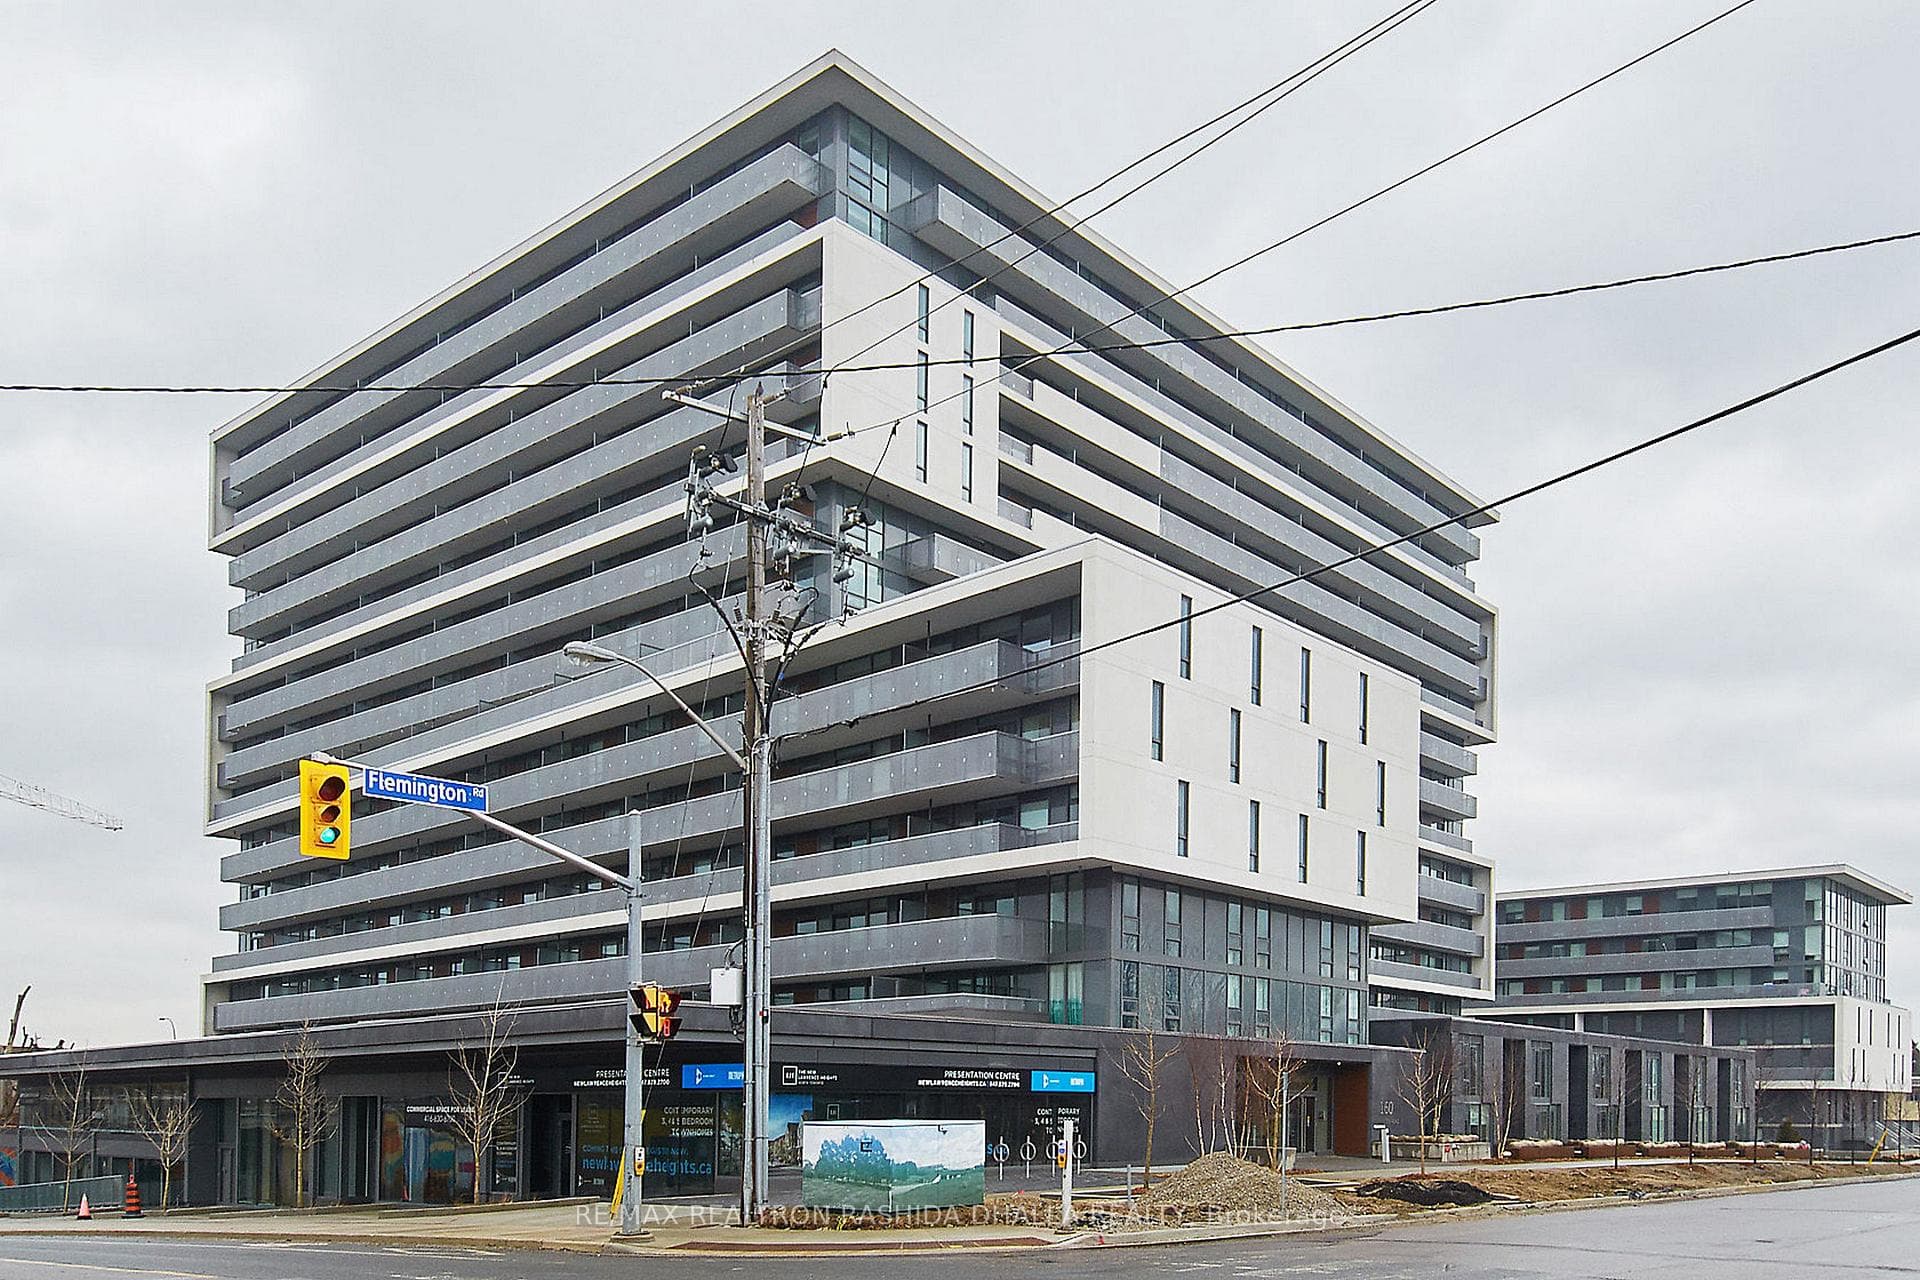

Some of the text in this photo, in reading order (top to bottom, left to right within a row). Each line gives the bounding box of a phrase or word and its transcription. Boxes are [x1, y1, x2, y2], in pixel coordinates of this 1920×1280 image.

[368, 770, 484, 803] Flemington Rd
[643, 1068, 670, 1078] CENTRE
[944, 1071, 1021, 1080] PRESENTATION CENTRE
